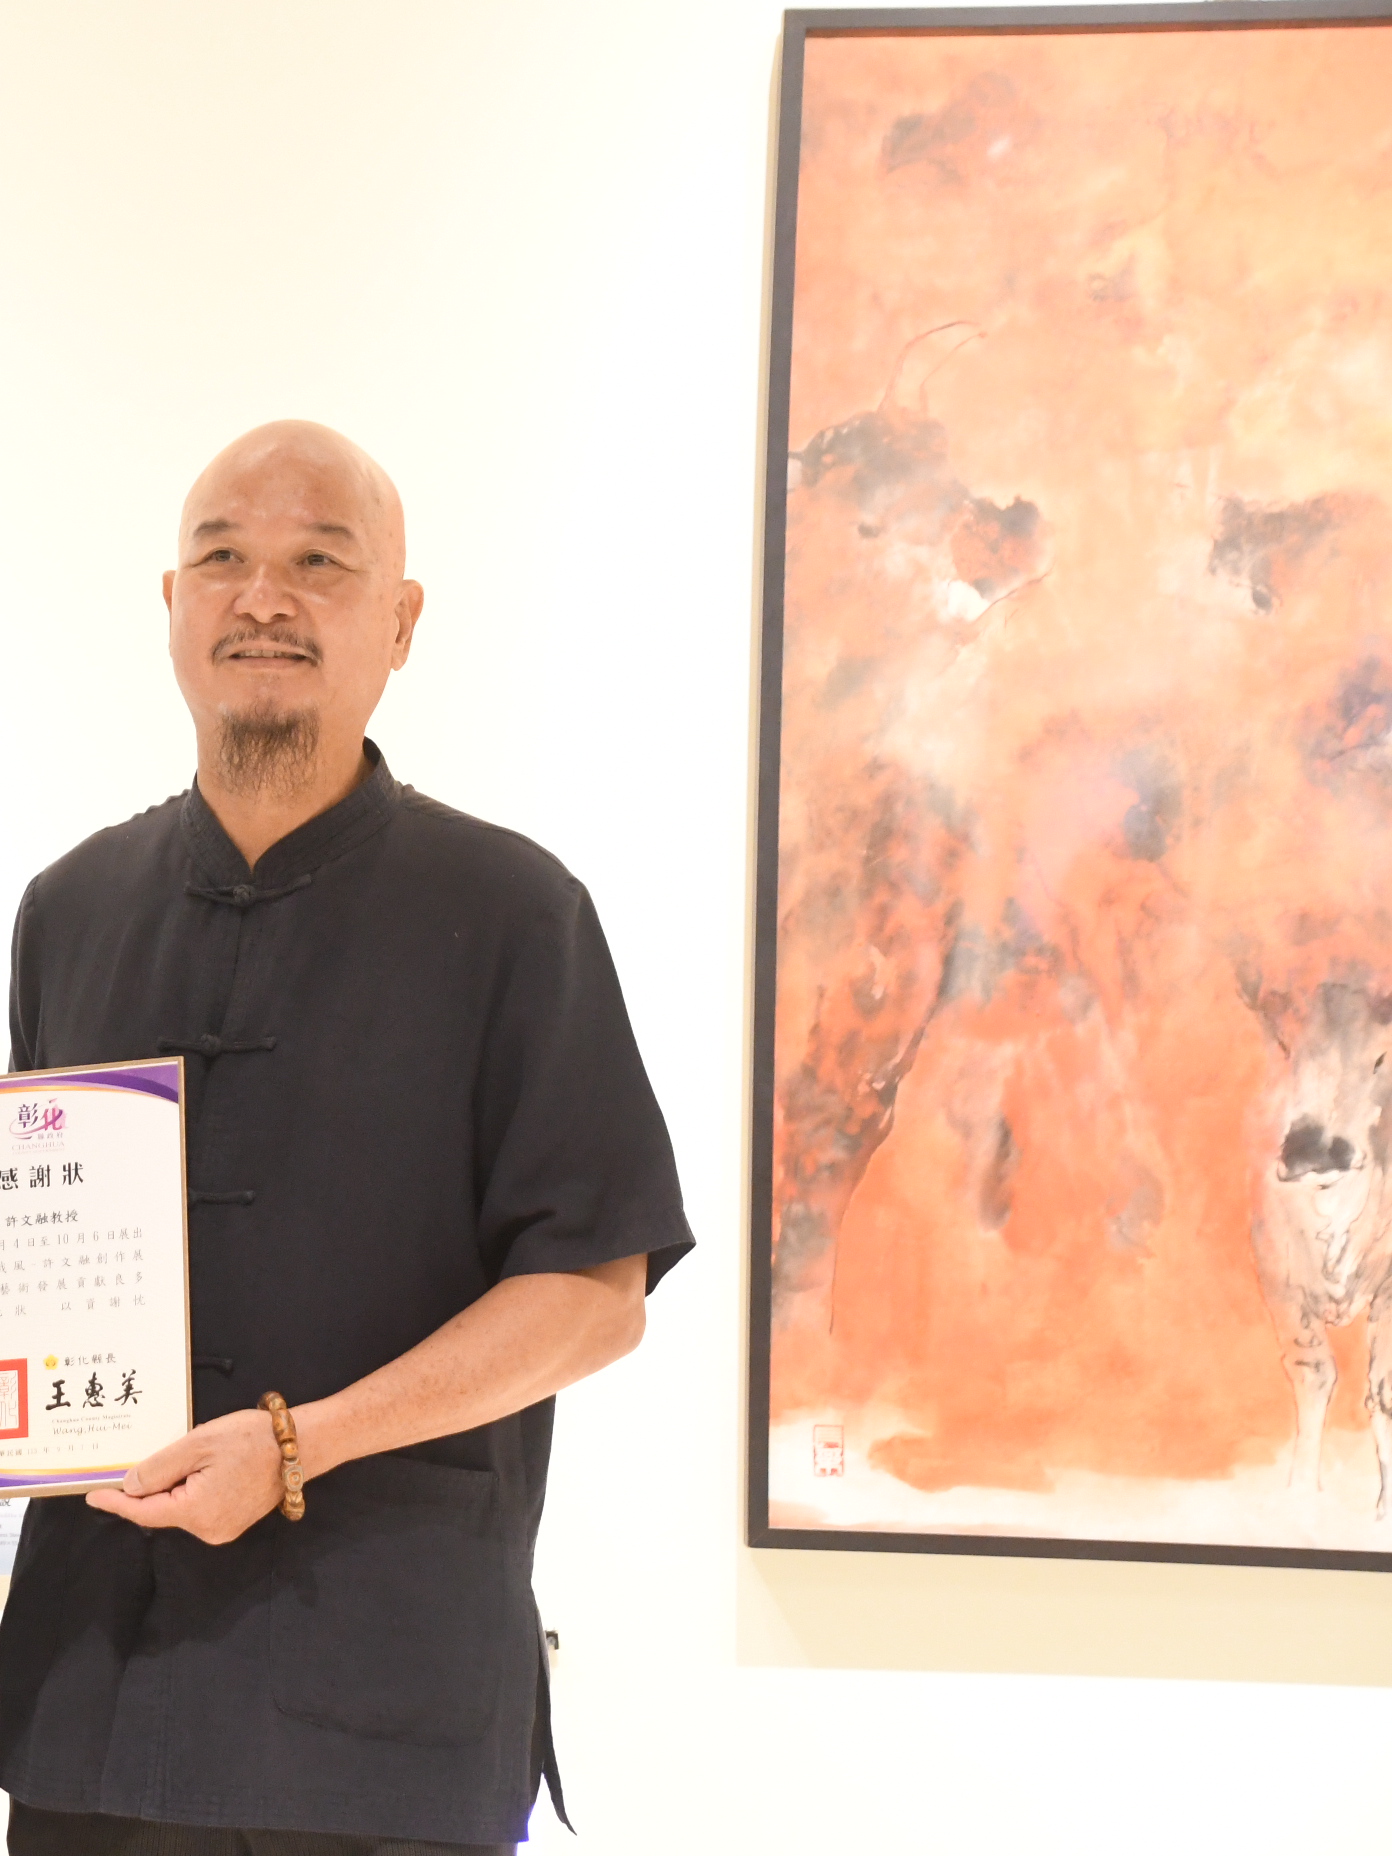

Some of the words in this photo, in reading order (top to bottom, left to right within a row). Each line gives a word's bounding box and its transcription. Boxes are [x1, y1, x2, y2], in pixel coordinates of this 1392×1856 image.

[17, 1101, 65, 1131] 彰化
[4, 1209, 79, 1227] 許文融教授
[64, 1352, 117, 1367] 彰化縣長
[45, 1369, 143, 1411] 王惠美
